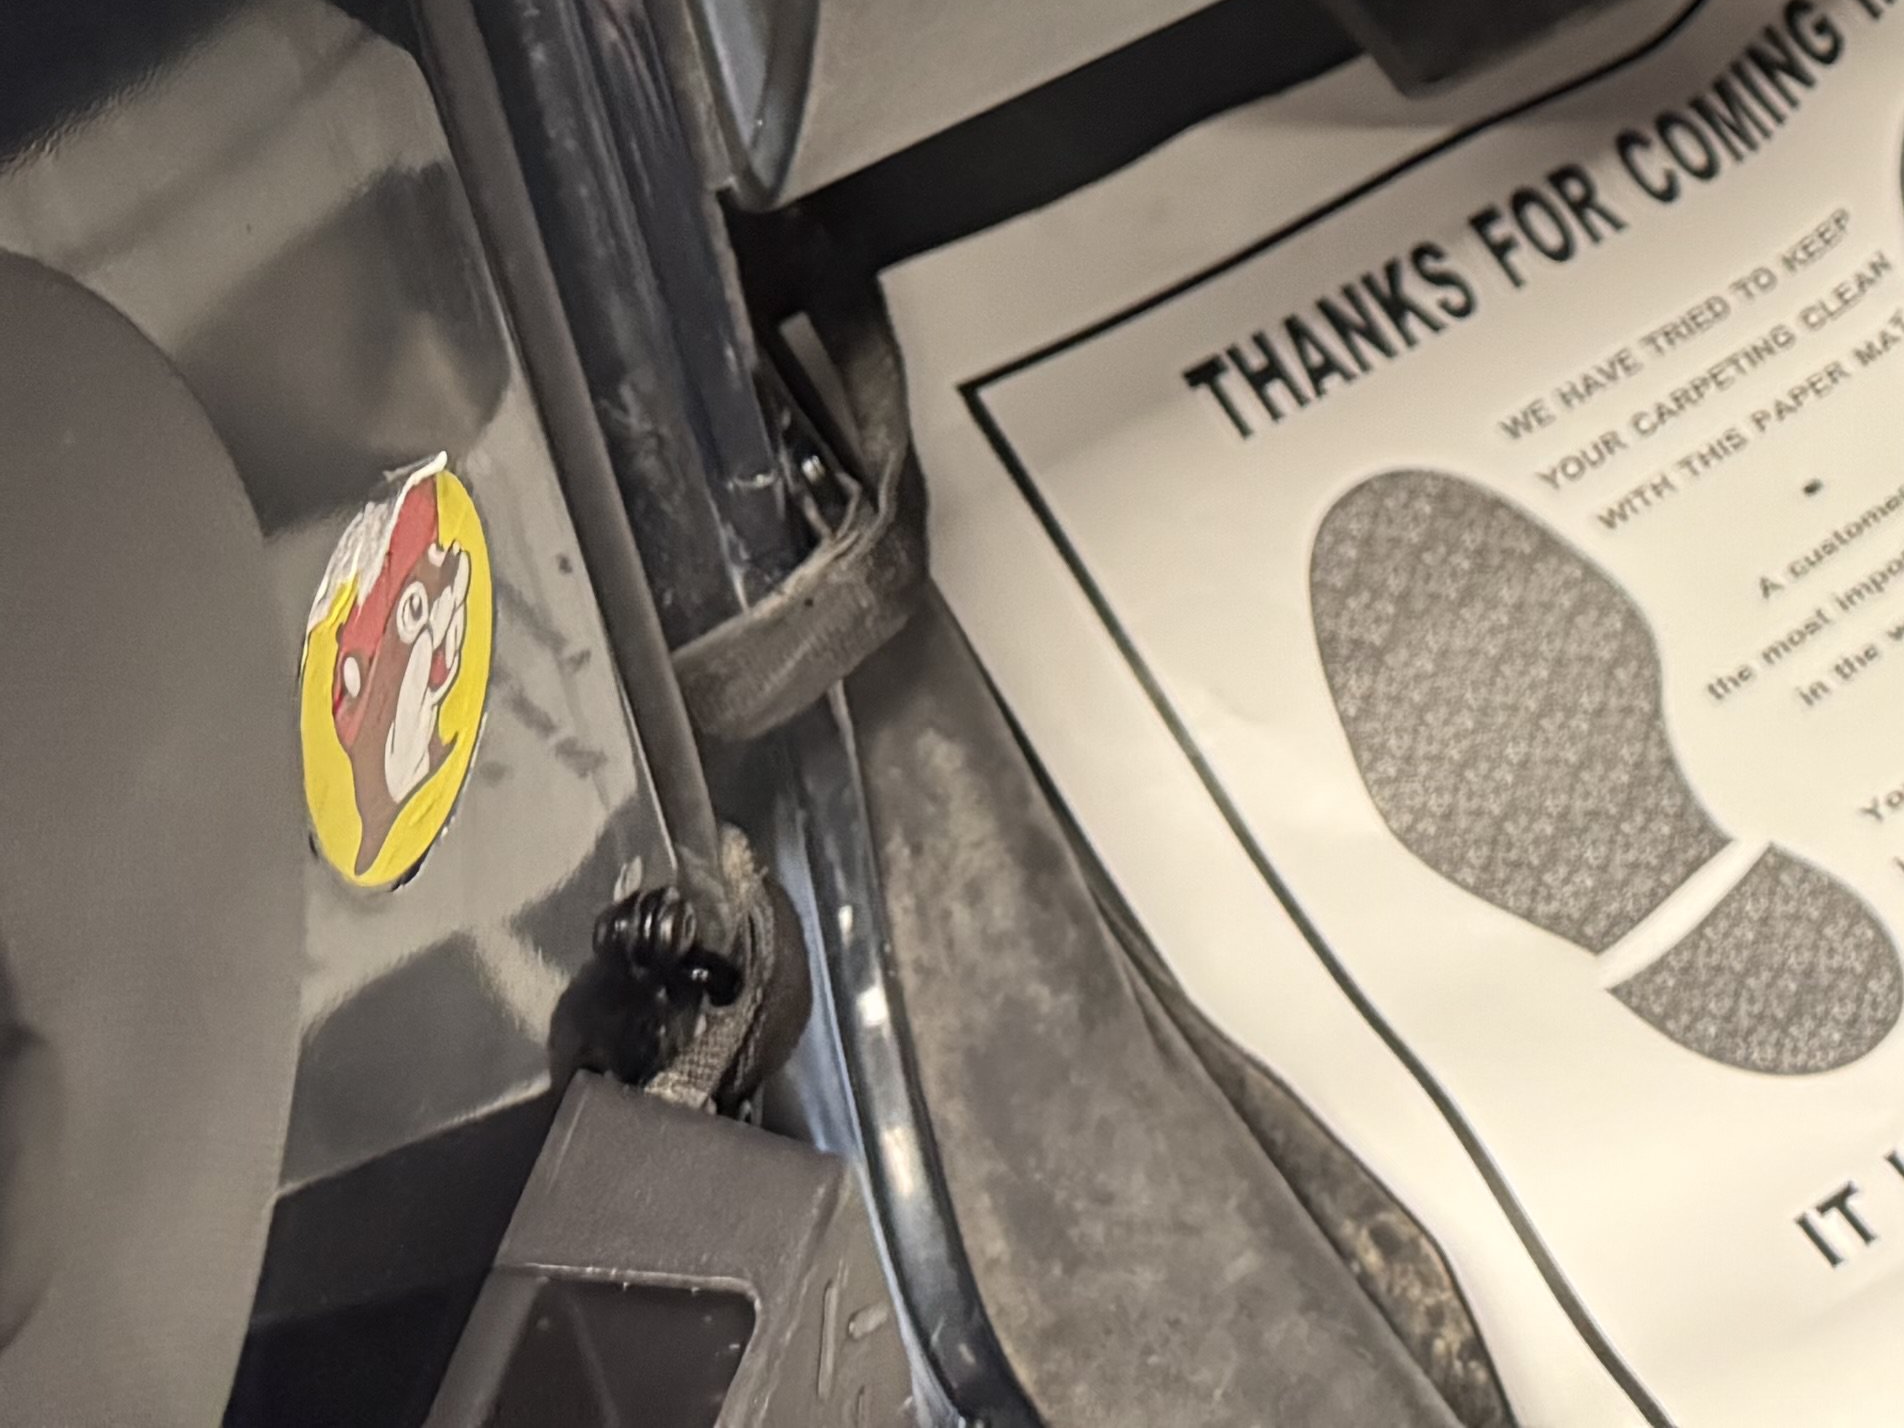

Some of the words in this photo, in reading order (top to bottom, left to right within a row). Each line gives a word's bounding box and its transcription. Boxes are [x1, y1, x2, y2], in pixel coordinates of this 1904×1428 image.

[1182, 239, 1479, 442] THANKS
[1468, 162, 1630, 289] FOR
[1499, 397, 1557, 441] WE
[1556, 347, 1644, 410] HAVE
[1640, 295, 1731, 358] TRIED
[1729, 266, 1778, 302] TO
[1781, 207, 1850, 275] KEEP
[1536, 430, 1628, 492] YOUR
[1631, 323, 1797, 438] CARPETING
[1800, 250, 1893, 332] CLEAN
[1596, 474, 1677, 531] WITH
[1677, 427, 1749, 480] THIS
[1749, 361, 1852, 434] PAPER
[1759, 576, 1785, 600] A
[1707, 665, 1755, 701] the
[1761, 608, 1833, 666] most
[1797, 680, 1832, 707] in
[1833, 643, 1880, 682] the
[1794, 1179, 1880, 1269] IT
